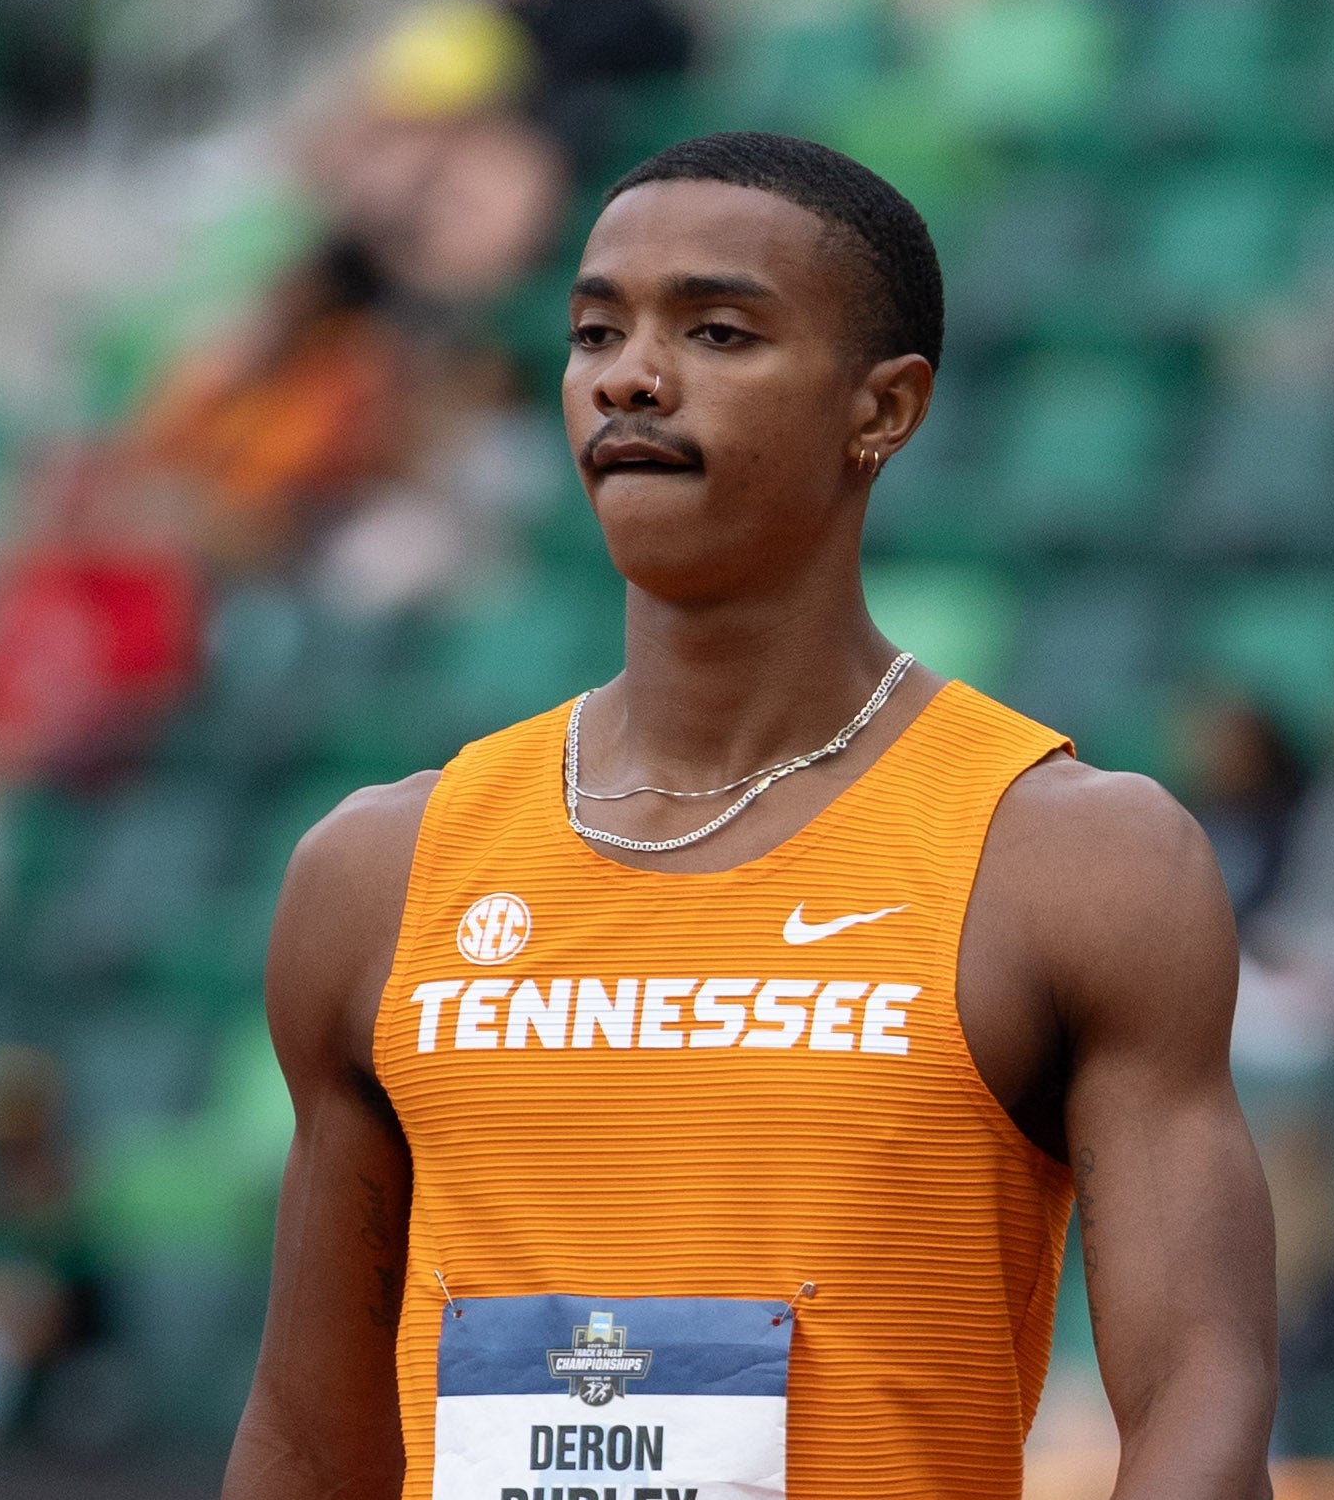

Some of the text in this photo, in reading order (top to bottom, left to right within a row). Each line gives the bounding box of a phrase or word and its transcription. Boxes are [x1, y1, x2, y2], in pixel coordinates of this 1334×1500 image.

[460, 897, 527, 961] SEC
[409, 977, 922, 1056] TENNESSEE
[555, 1357, 644, 1371] CHAMPIONSHIPS
[574, 1348, 596, 1357] TRACK
[603, 1348, 623, 1358] FIELD
[529, 1425, 664, 1472] DERON
